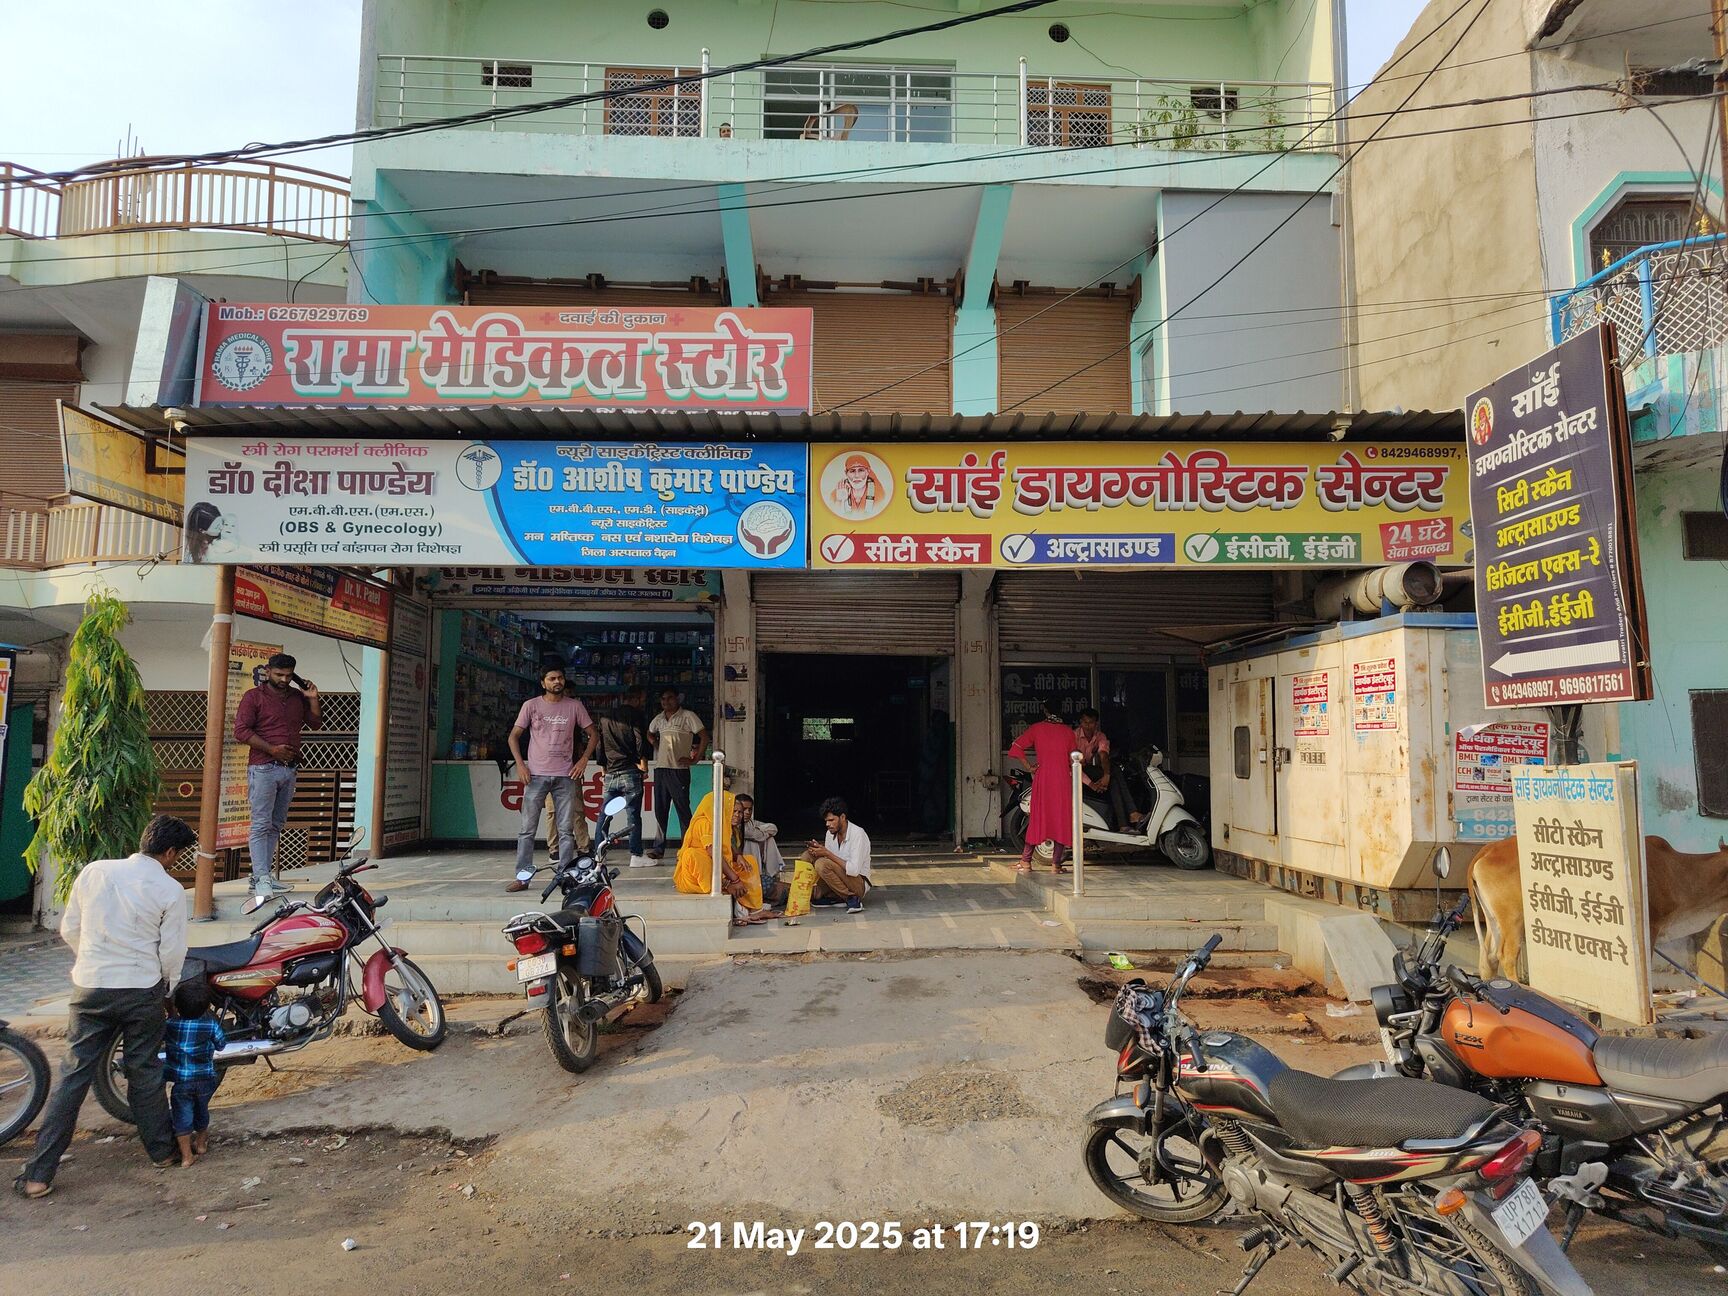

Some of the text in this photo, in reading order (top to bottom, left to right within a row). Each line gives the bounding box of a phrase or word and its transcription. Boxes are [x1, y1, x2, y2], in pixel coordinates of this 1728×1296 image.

[219, 307, 368, 321] Mob.: 6267929769
[559, 309, 666, 328] दवाई की दुकान
[227, 332, 260, 343] MEDICAL
[259, 340, 272, 361] STORE
[283, 310, 793, 400] रामा मेडिकल स्टोर
[241, 443, 428, 457] स्त्री रोग परामर्श क्लीनिक
[556, 444, 594, 462] न्यूरो
[684, 446, 752, 460] क्लीनिक
[1381, 447, 1461, 460] 8429468997,
[1475, 407, 1597, 477] डायग्नोस्टिक सेन्टर
[262, 460, 330, 497] दीक्षा
[337, 461, 435, 495] पाण्डेय
[561, 461, 642, 493] आशीष
[649, 466, 713, 500] कुमार
[719, 464, 795, 494] पाण्डेय
[1012, 450, 1309, 516] डायग्नोस्टिक
[1315, 450, 1449, 513] सेन्टर
[1496, 467, 1572, 514] सिटी स्कैन
[279, 521, 443, 537] (OBS & Gynecology)
[590, 518, 613, 529] न्यूरो
[1389, 520, 1447, 545] 24 घंटे
[1496, 504, 1580, 548] अल्ट्रासाउण्ड
[258, 541, 461, 556] स्त्री प्रसूति एवं बांझपन रोग विशेषज्ञ
[524, 532, 544, 541] मन
[601, 533, 621, 542] नस
[624, 531, 643, 543] एवं
[645, 533, 689, 544] नशारोग
[692, 533, 734, 545] विशेषज्ञ
[864, 536, 981, 562] सीटी स्कैन
[1046, 538, 1162, 562] अल्ट्रासाउण्ड
[1225, 536, 1356, 560] ईसीजी, ईईजी
[1387, 541, 1450, 558] सेवा उपलब्ध
[581, 547, 607, 557] जिला
[608, 548, 652, 558] अस्पताल
[1486, 536, 1600, 592] डिजिटल एक्स-रे
[345, 579, 354, 596] Dr.
[356, 583, 362, 599] V.
[363, 587, 380, 605] Patel
[1502, 672, 1624, 700] 8429468997, 9696817561
[1457, 767, 1472, 775] CCH
[1459, 753, 1522, 764] BMLT DMLT
[1532, 769, 1586, 800] डायग्नोस्टिक
[1587, 771, 1614, 801] सेन्टर
[1533, 817, 1603, 848] सीटी स्कैन
[1531, 852, 1614, 880] अल्ट्रासाउण्ड
[1528, 882, 1624, 925] ईसीजी, ईईजी
[1531, 918, 1629, 966] डीआर एक्स-रे
[1557, 1108, 1583, 1119] YAMAHA
